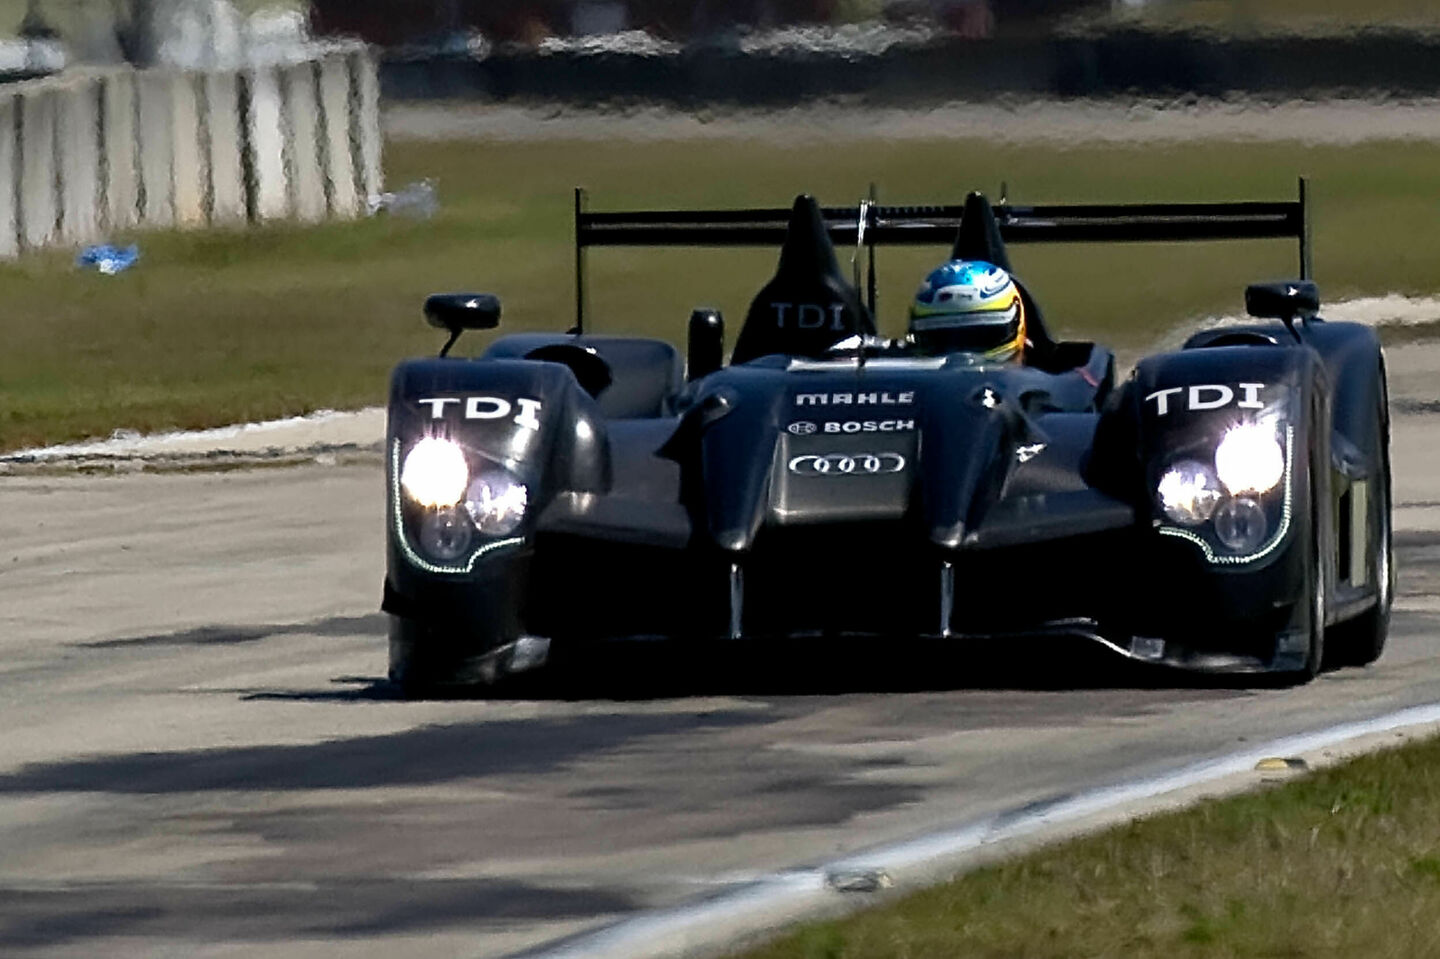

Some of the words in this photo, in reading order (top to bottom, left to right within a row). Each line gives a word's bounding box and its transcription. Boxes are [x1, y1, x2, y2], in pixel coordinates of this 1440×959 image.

[770, 302, 845, 331] TDI
[796, 391, 915, 406] MAHLE
[1145, 382, 1265, 416] TDI
[418, 396, 542, 431] TDI
[824, 420, 915, 433] BOSCH
